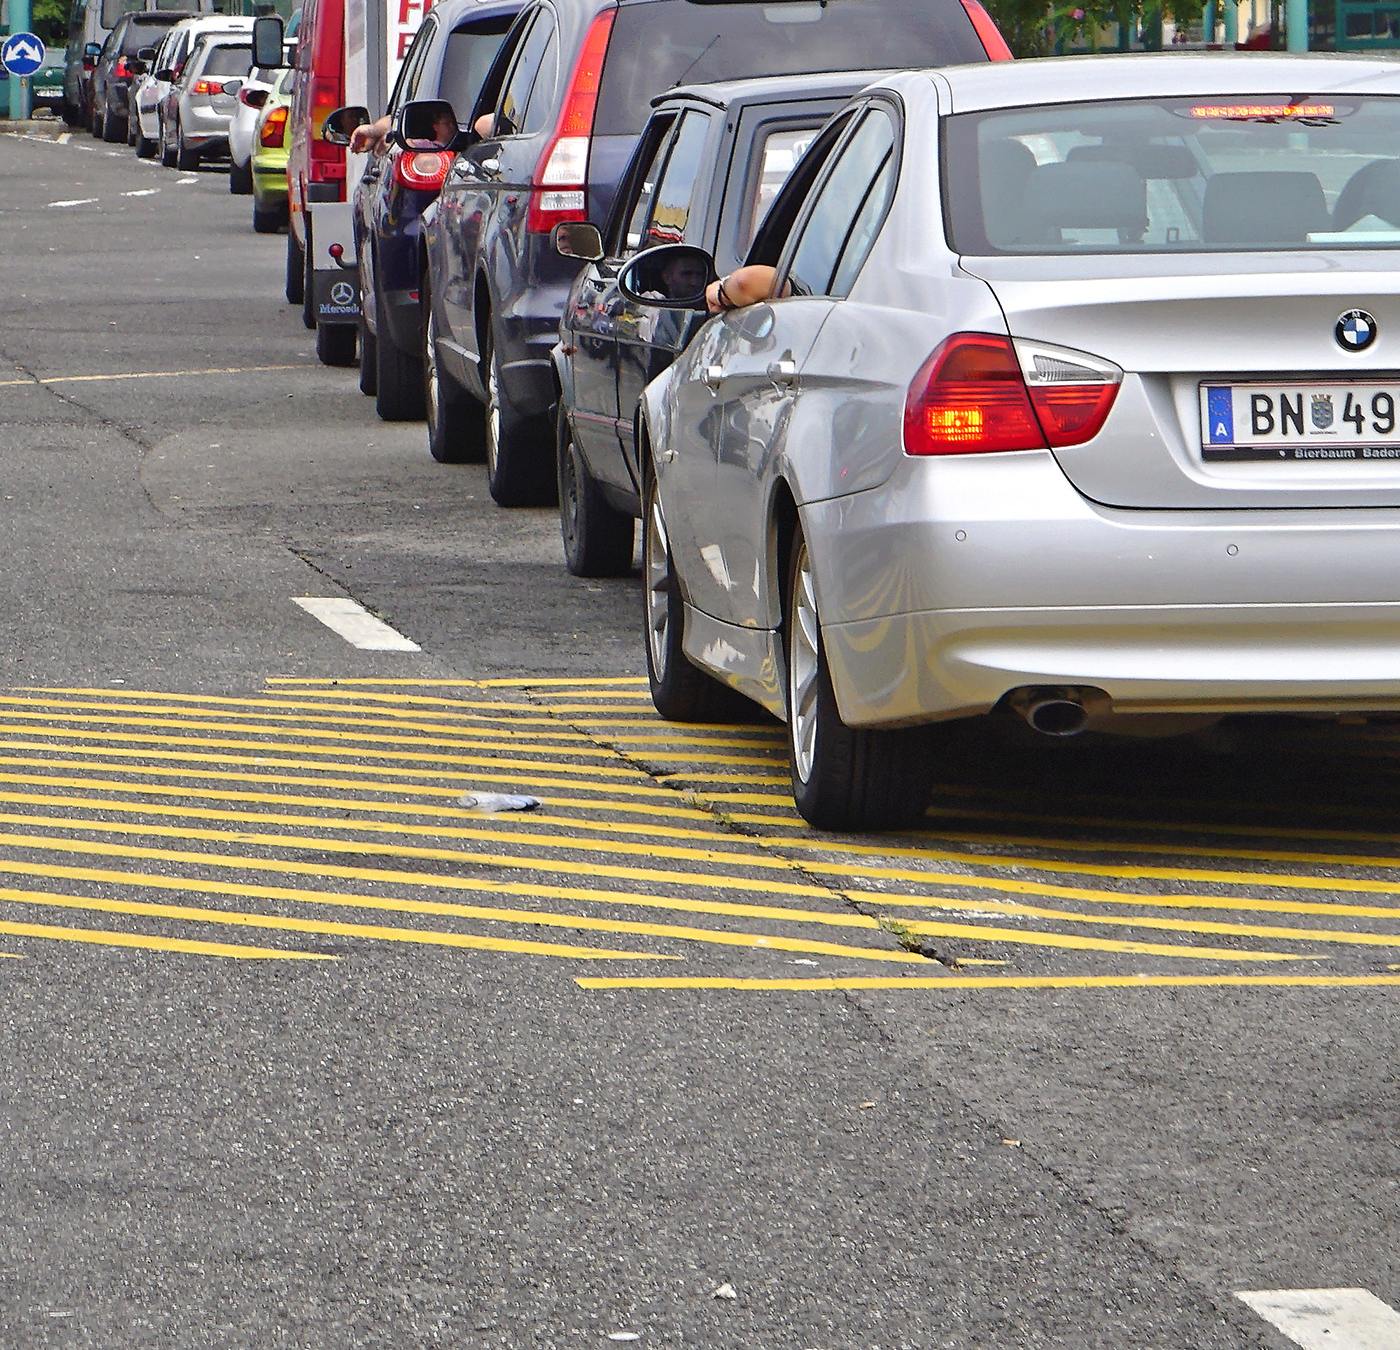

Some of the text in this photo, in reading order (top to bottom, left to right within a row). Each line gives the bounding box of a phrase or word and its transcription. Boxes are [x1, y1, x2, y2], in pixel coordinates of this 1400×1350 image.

[1215, 422, 1228, 437] A
[1251, 393, 1304, 436] BN
[1295, 449, 1356, 459] Bierbaum
